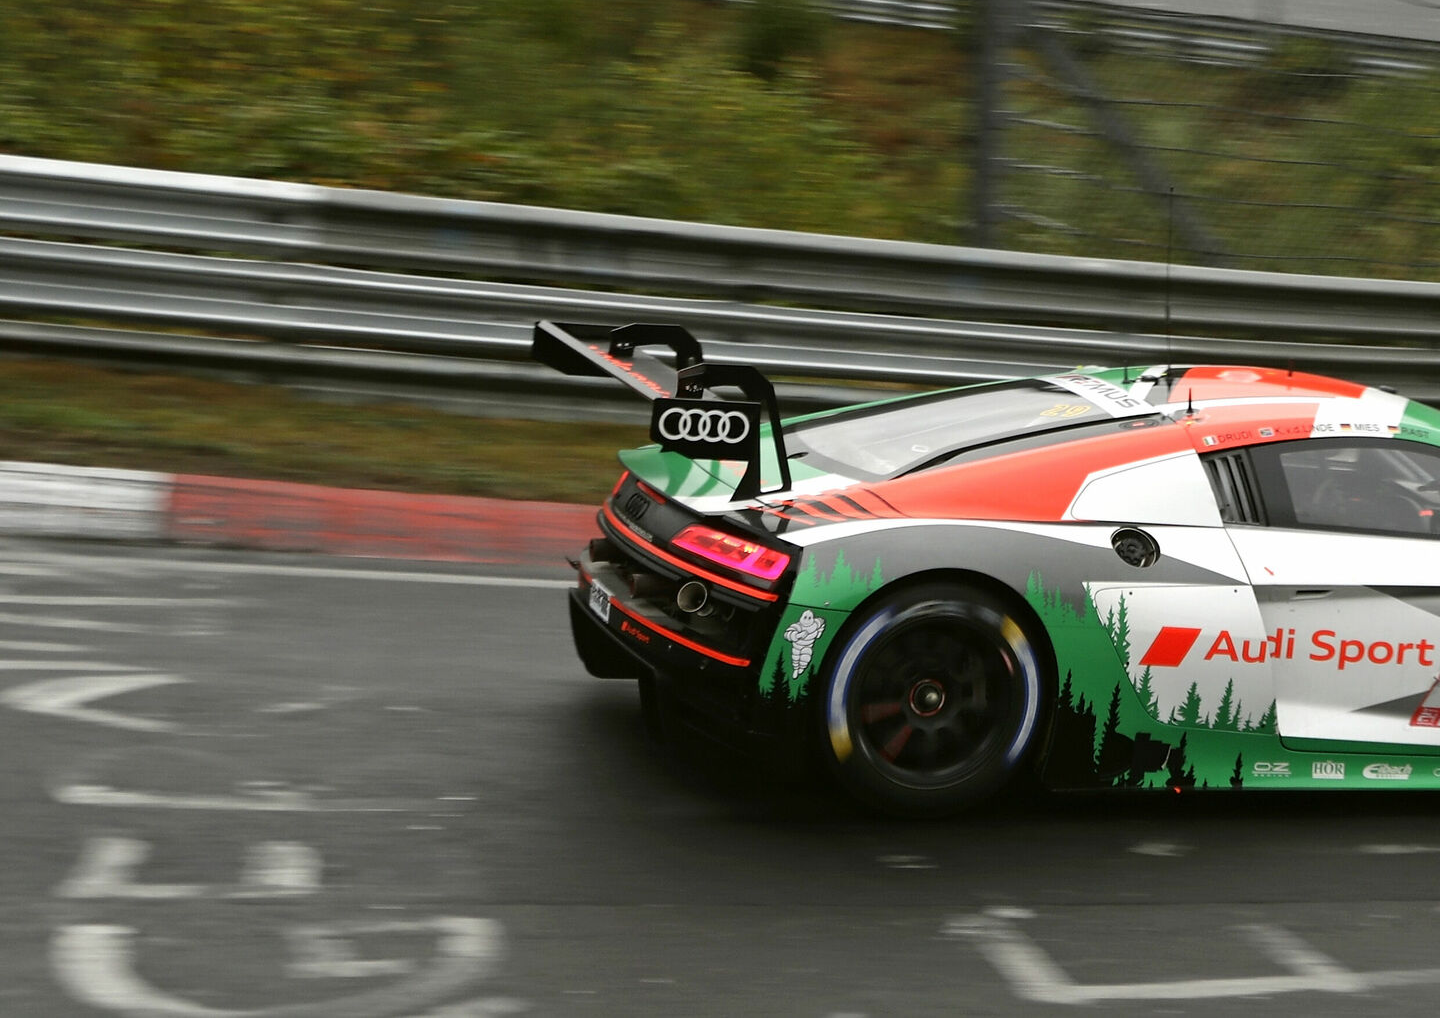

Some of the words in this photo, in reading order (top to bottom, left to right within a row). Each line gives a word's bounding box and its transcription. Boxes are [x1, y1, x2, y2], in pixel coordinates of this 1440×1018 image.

[1354, 423, 1379, 432] MIES
[1204, 628, 1296, 663] Audi
[1309, 630, 1436, 670] Sport
[1253, 762, 1290, 772] OZ
